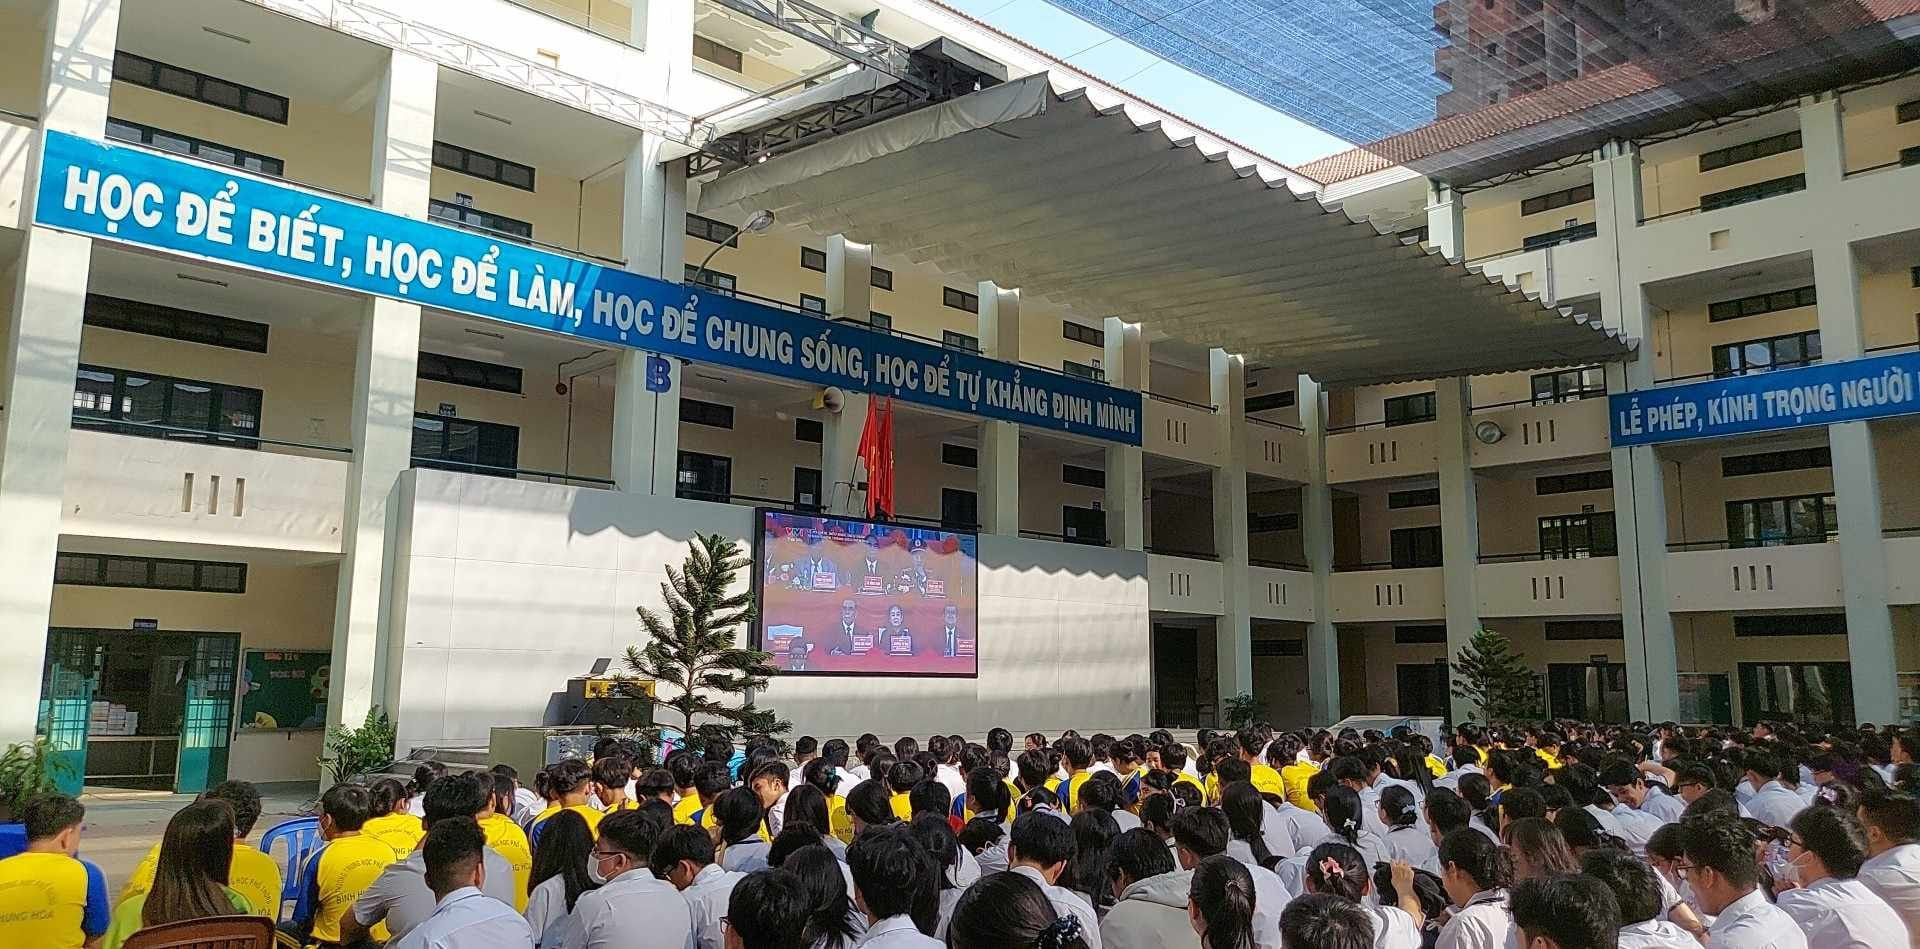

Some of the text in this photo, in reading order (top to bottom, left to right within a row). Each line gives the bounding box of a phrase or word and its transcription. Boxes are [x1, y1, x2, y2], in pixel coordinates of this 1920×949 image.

[63, 165, 1136, 434] HỌC ĐỂ BIẾT, HỌC ĐỂ LÀM, HỌC ĐỂ CHUNG SỐNG, HỌC ĐỂ TỰ KHẲNG ĐỊNH MÌNH
[646, 355, 671, 393] B
[1620, 396, 1643, 436] LỄ
[1648, 396, 1703, 433] PHÉP,
[1708, 389, 1758, 425] KÍNH
[1763, 383, 1837, 423] TRỌNG
[1841, 366, 1913, 409] NGƯỜI
